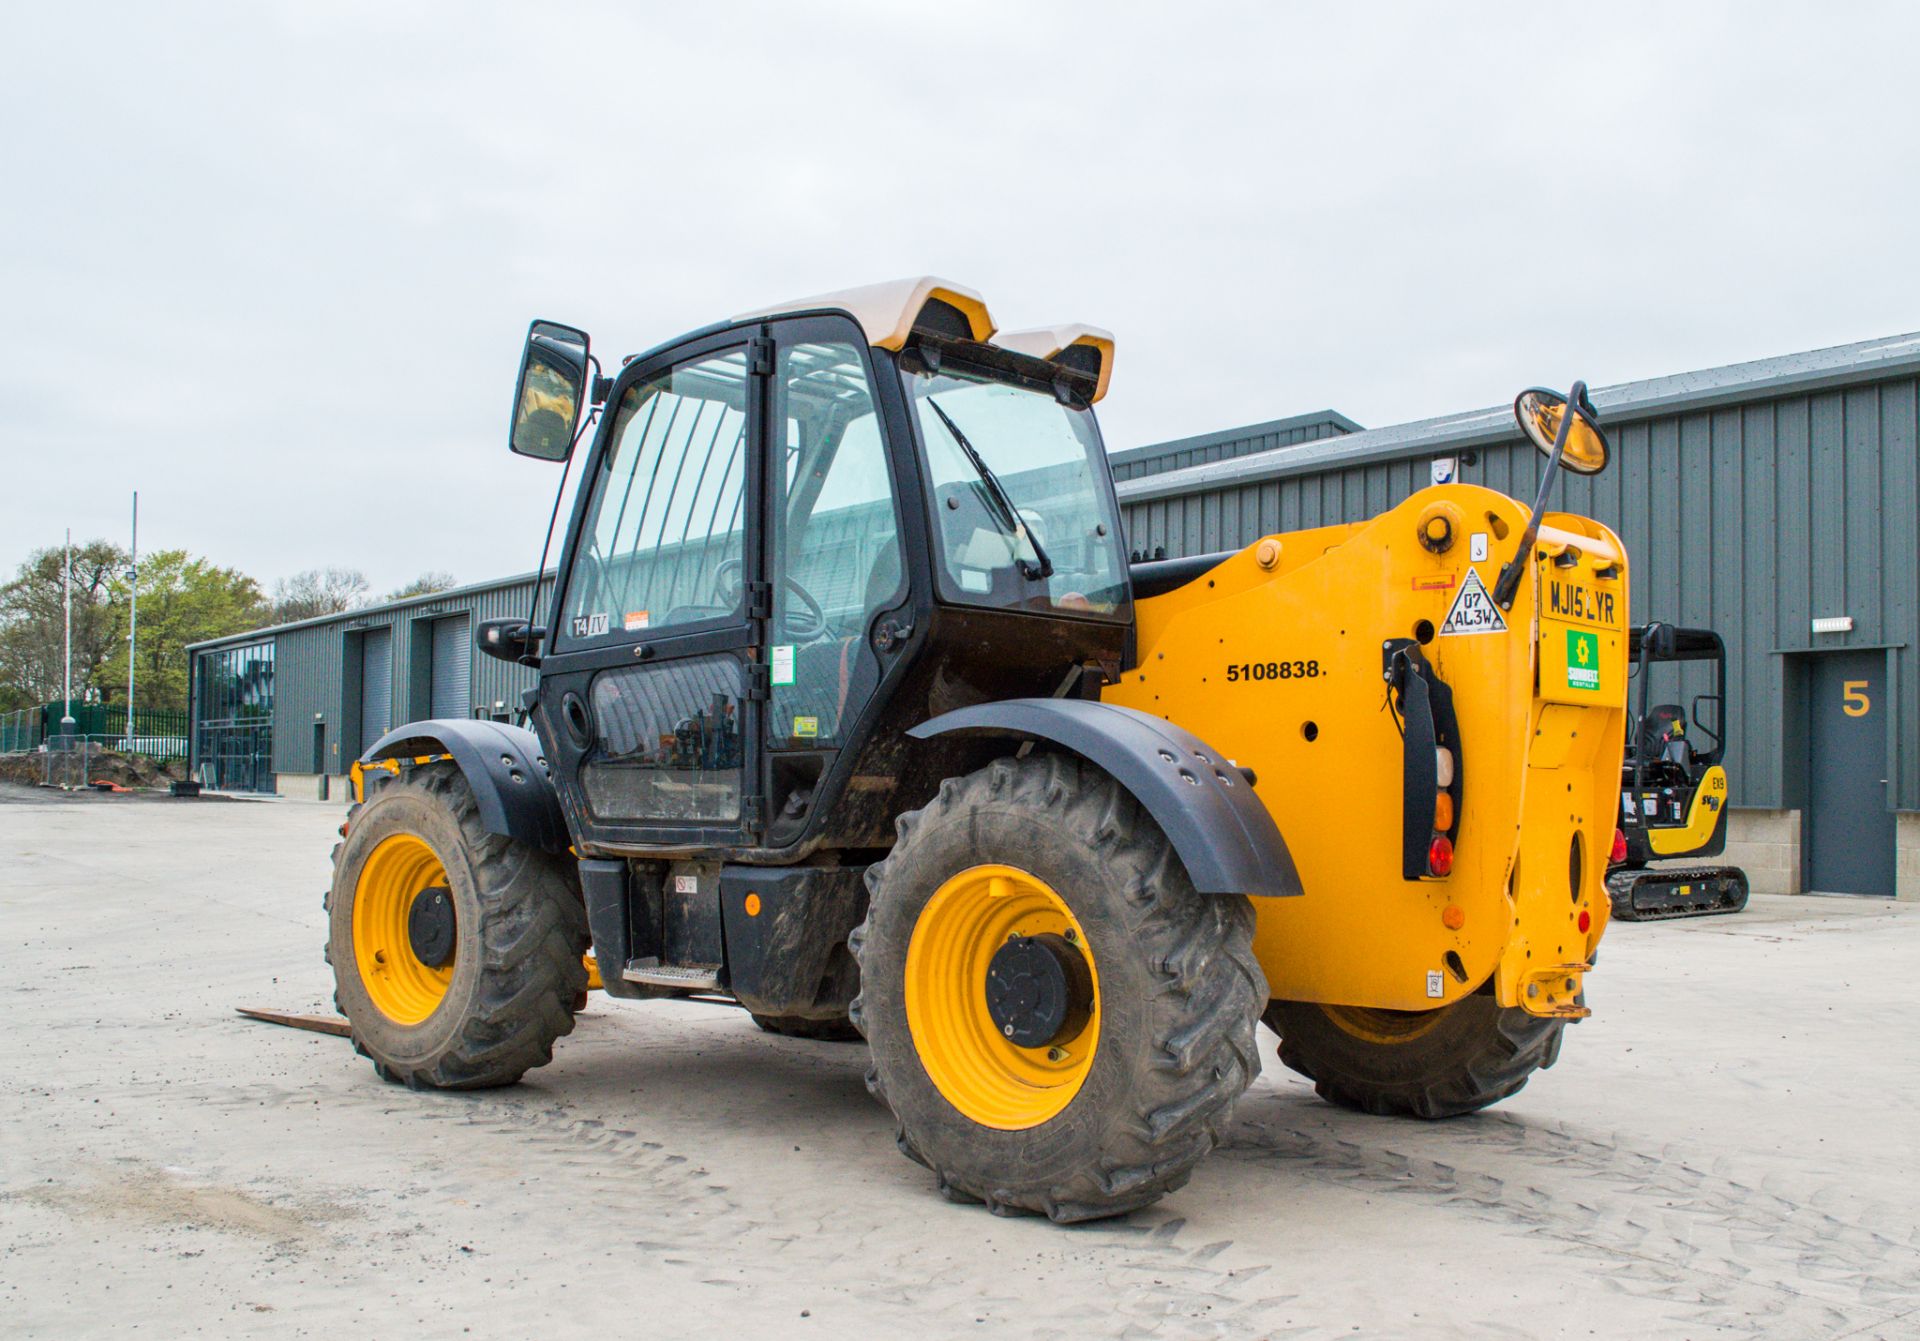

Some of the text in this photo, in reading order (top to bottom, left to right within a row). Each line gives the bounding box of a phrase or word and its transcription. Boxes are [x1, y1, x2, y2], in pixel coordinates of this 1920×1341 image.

[1551, 580, 1583, 618] MJ15
[573, 617, 588, 636] T4
[590, 615, 607, 634] IV
[1455, 608, 1492, 626] AL3W
[1226, 660, 1320, 682] 5108838
[1842, 680, 1870, 717] 5
